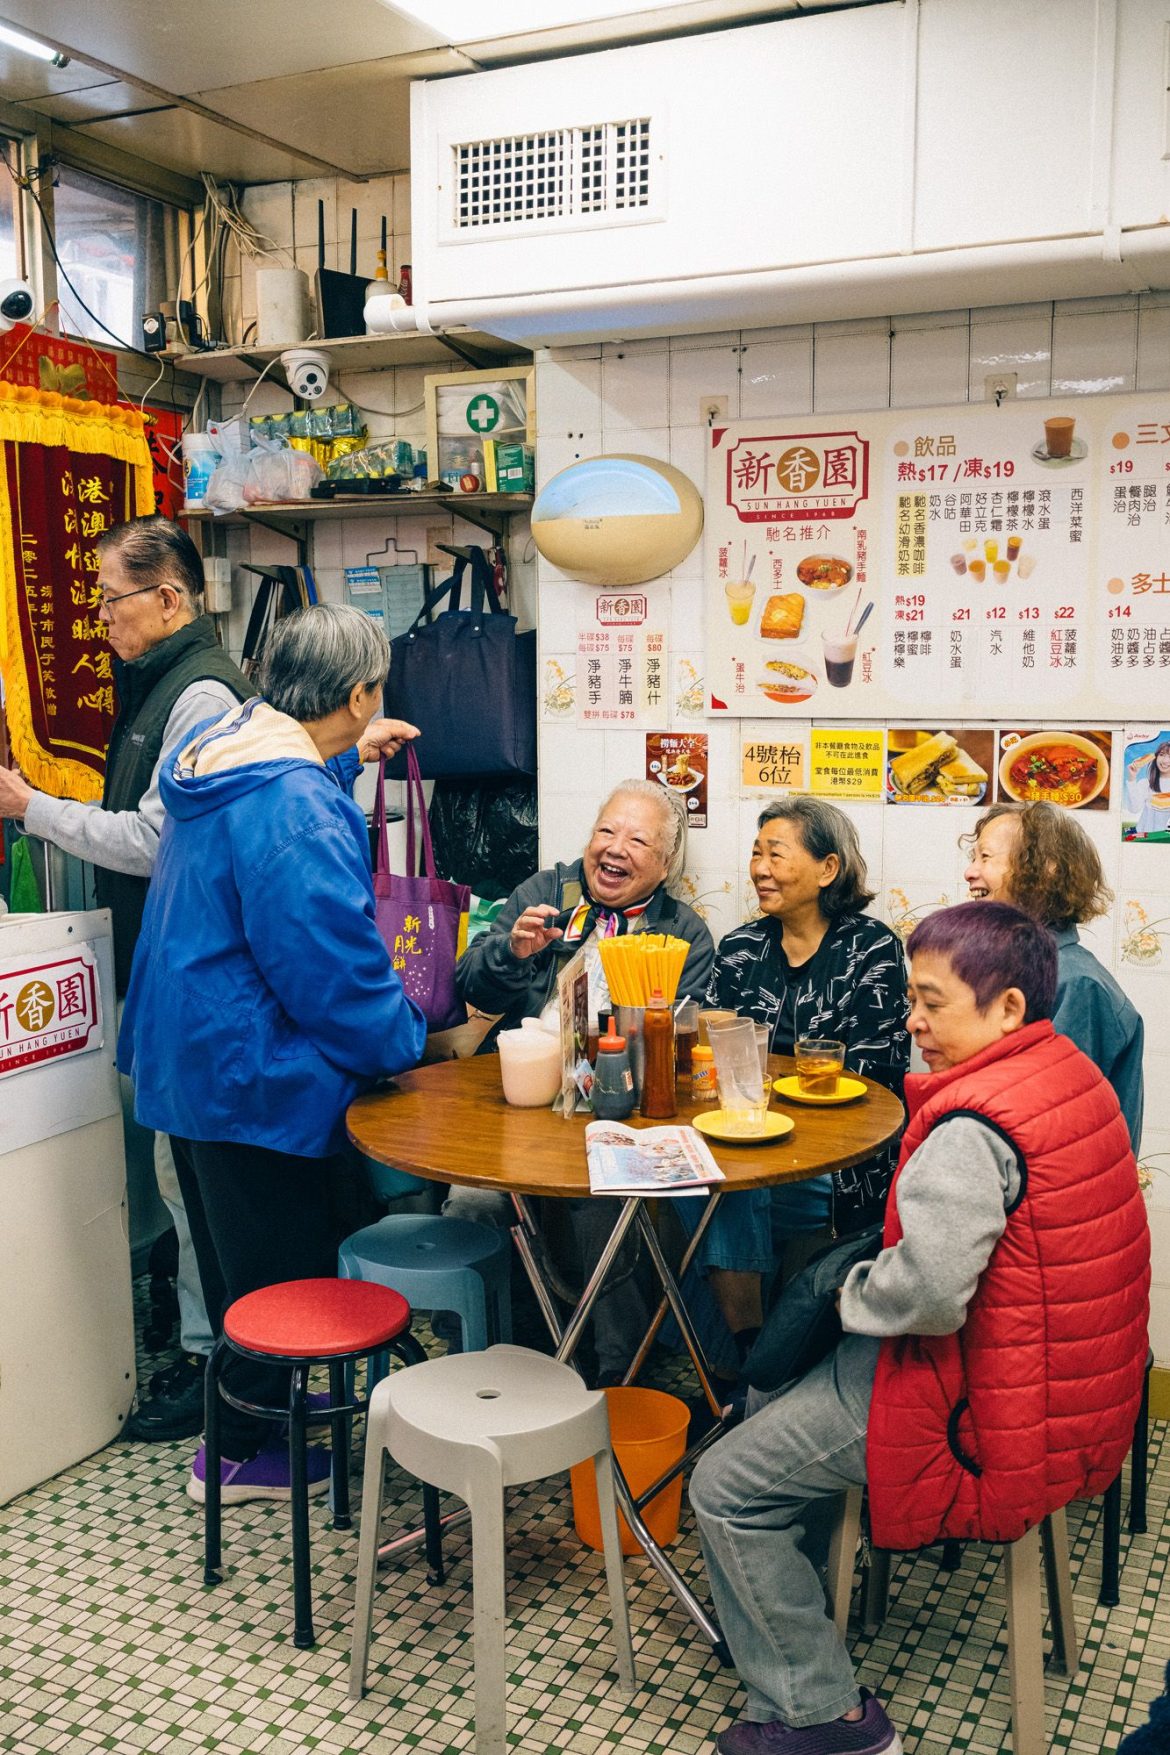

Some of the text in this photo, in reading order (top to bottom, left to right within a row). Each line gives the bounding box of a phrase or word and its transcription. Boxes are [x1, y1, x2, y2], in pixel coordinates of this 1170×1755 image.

[914, 434, 958, 458] 飲品
[733, 446, 857, 495] 新香園
[1109, 460, 1134, 474] $19
[747, 498, 846, 510] SUN HANG YUEN
[929, 494, 942, 521] 奶水
[944, 493, 957, 520] 谷咕
[959, 493, 972, 533] 阿華田
[974, 492, 988, 532] 好立克
[990, 492, 1003, 532] 杏仁霜
[1006, 490, 1019, 531] 檸檬茶
[1022, 490, 1035, 530] 檸檬水
[1038, 489, 1052, 530] 滾水蛋
[1113, 486, 1127, 513] 蛋治
[1127, 485, 1141, 526] 餐肉治
[1069, 488, 1084, 543] 西洋菜蜜
[766, 524, 831, 542] 馳名推介
[898, 496, 911, 576] 馳名幼滑奶茶
[913, 495, 926, 575] 馳名香濃咖啡
[773, 558, 782, 590] 西多士
[1131, 572, 1170, 595] 多士
[599, 598, 643, 616] 新香園
[894, 610, 924, 621] 凍$21
[952, 608, 971, 620] $21
[986, 607, 1006, 619] $12
[1018, 607, 1040, 619] $13
[1054, 606, 1075, 619] $22
[1108, 605, 1131, 618] $14
[618, 644, 633, 652] $75
[647, 644, 662, 652] $80
[950, 629, 962, 669] 奶水蛋
[990, 629, 1002, 656] 汽水
[1022, 629, 1036, 668] 維他奶
[1050, 629, 1063, 668] 紅豆冰
[1064, 628, 1078, 668] 菠蘿冰
[1110, 628, 1124, 668] 奶油多
[1143, 627, 1157, 668] 油占多
[862, 652, 872, 684] 紅豆冰
[620, 710, 635, 719] $78
[745, 745, 801, 765] 4號枱
[758, 766, 792, 785] 6位
[19, 1036, 48, 1053] HANG
[54, 1027, 80, 1043] YUEN
